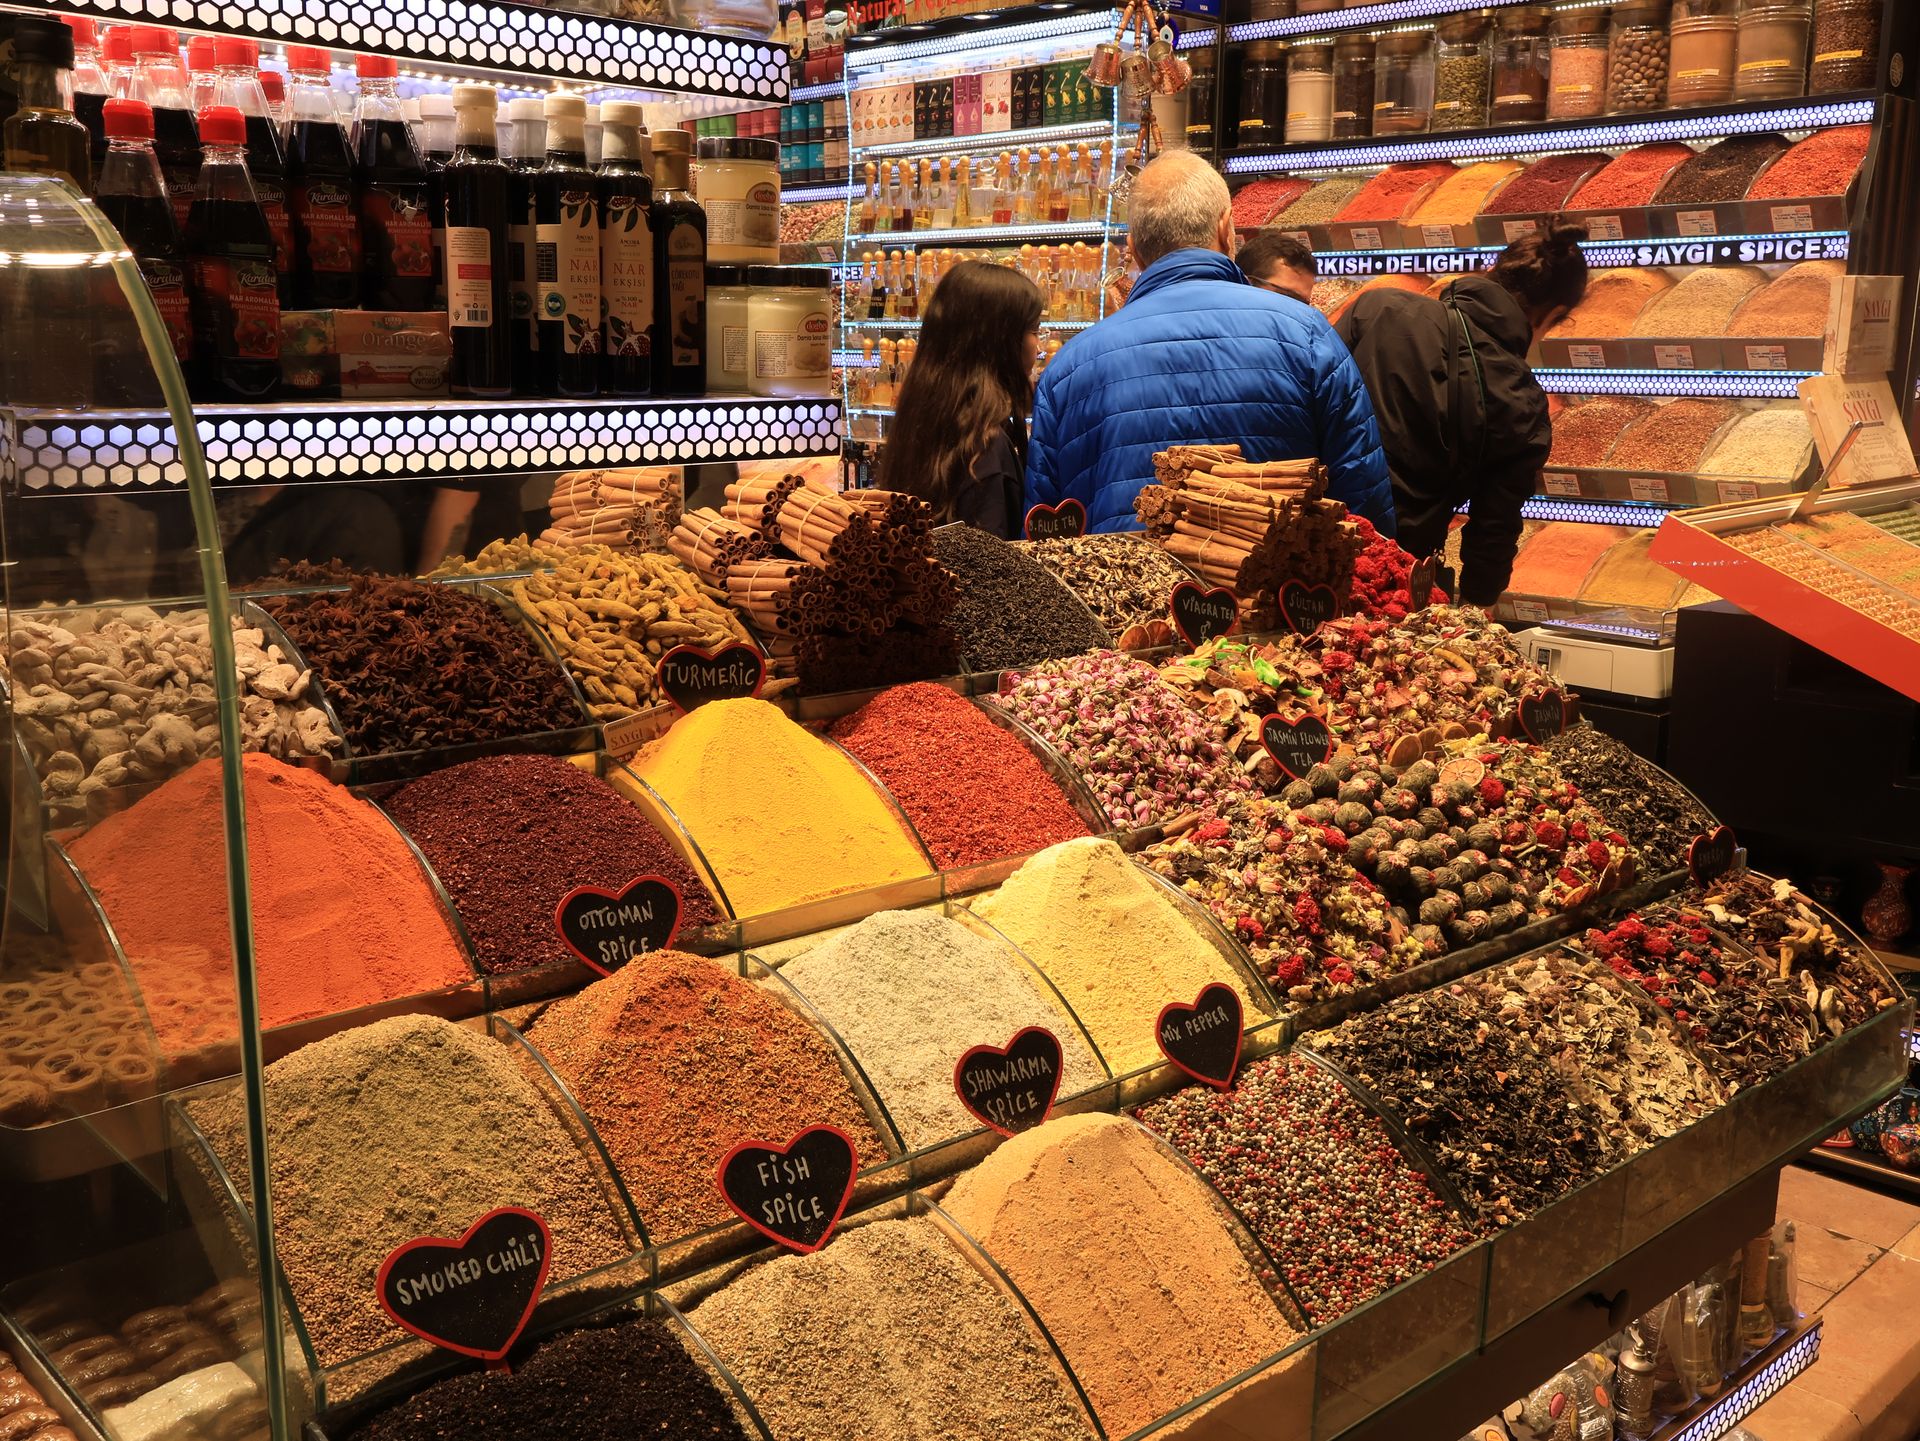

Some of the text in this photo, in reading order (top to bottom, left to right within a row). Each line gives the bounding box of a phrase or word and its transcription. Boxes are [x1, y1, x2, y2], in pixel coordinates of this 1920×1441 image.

[846, 0, 907, 27] Natural
[1636, 238, 1822, 266] SAYGI SPICE
[570, 259, 598, 271] NAR
[613, 263, 645, 275] NAR
[832, 267, 858, 280] PICE
[1316, 253, 1479, 275] RKISH DELIGHT
[1863, 300, 1891, 318] SAYGI
[362, 331, 427, 350] Orange
[1842, 399, 1883, 422] SAYGI
[1220, 606, 1235, 621] TEA
[1299, 617, 1316, 630] TEA
[610, 728, 643, 748] SAYGI
[1300, 731, 1329, 746] FLOWER
[1291, 752, 1314, 767] TEA
[579, 900, 654, 930] OTTOMAN
[1185, 1005, 1230, 1037] PEPPER
[965, 1056, 1052, 1098] SHAWARMA
[396, 1257, 482, 1306] SMOKED
